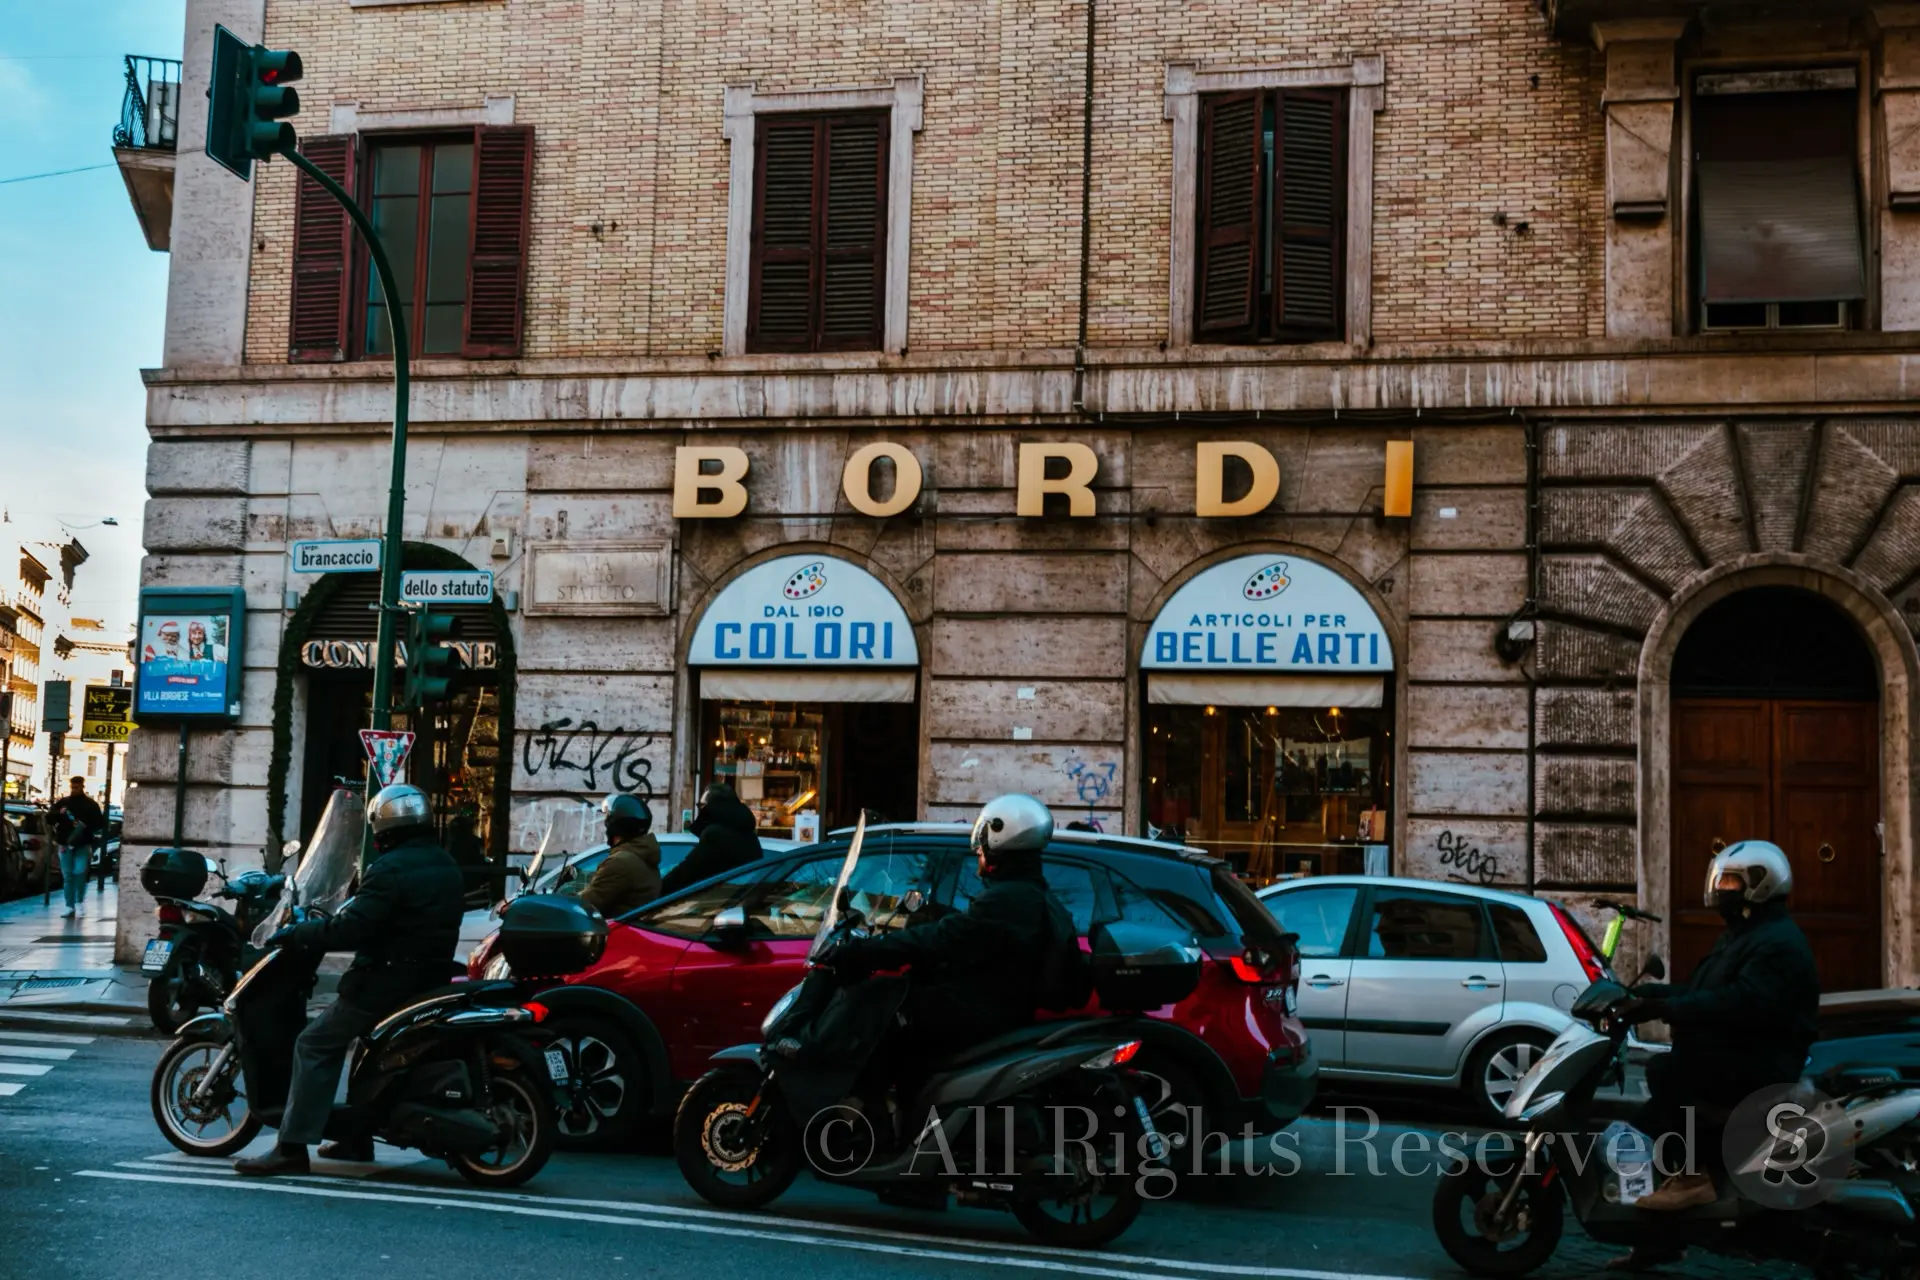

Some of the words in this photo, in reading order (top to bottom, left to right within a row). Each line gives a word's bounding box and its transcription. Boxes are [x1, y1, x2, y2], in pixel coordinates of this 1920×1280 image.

[673, 440, 1414, 518] BORDI
[301, 549, 373, 566] brancaccio
[404, 579, 438, 596] dello
[441, 579, 489, 596] statuto
[558, 585, 635, 600] STATUTO
[763, 605, 800, 618] DAL
[808, 605, 844, 618] 1910
[1189, 614, 1292, 627] ARTICOLI
[1304, 614, 1347, 627] PER
[714, 622, 893, 660] COLORI
[1155, 631, 1277, 664] BELLE
[1291, 632, 1378, 665] ARTI
[95, 725, 128, 736] ORO
